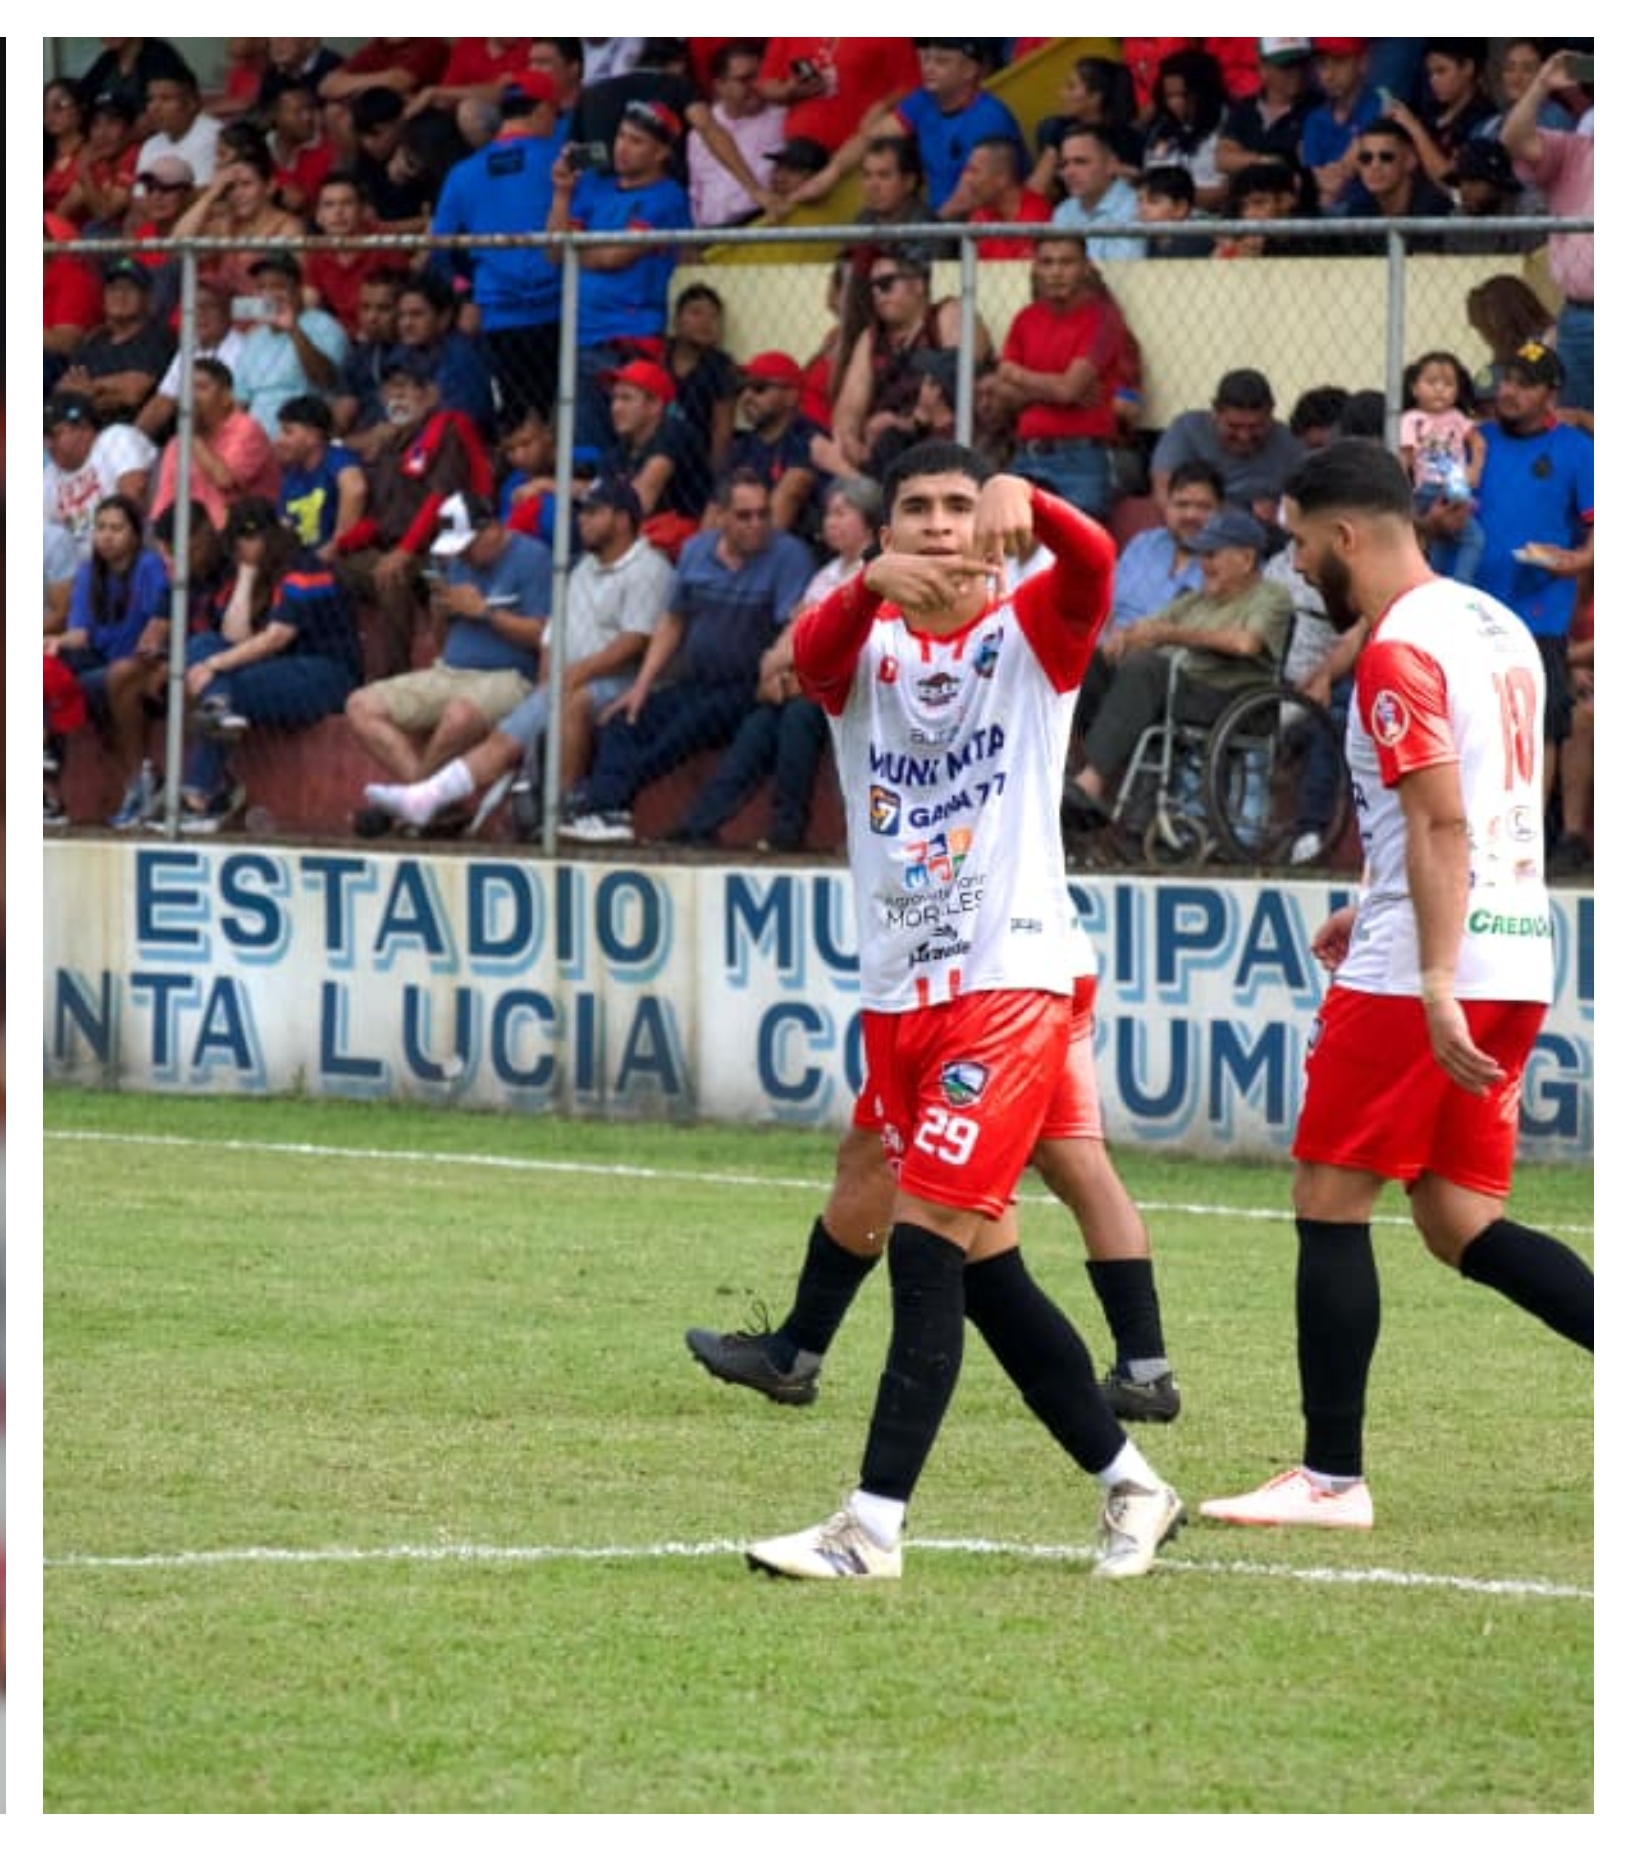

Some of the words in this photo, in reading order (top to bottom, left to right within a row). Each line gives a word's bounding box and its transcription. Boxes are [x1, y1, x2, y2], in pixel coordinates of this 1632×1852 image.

[946, 723, 1005, 781] MTA
[135, 850, 662, 966] ESTADIO
[887, 889, 984, 928] MORLES
[320, 981, 680, 1095] LUCIA
[914, 1106, 979, 1166] 29
